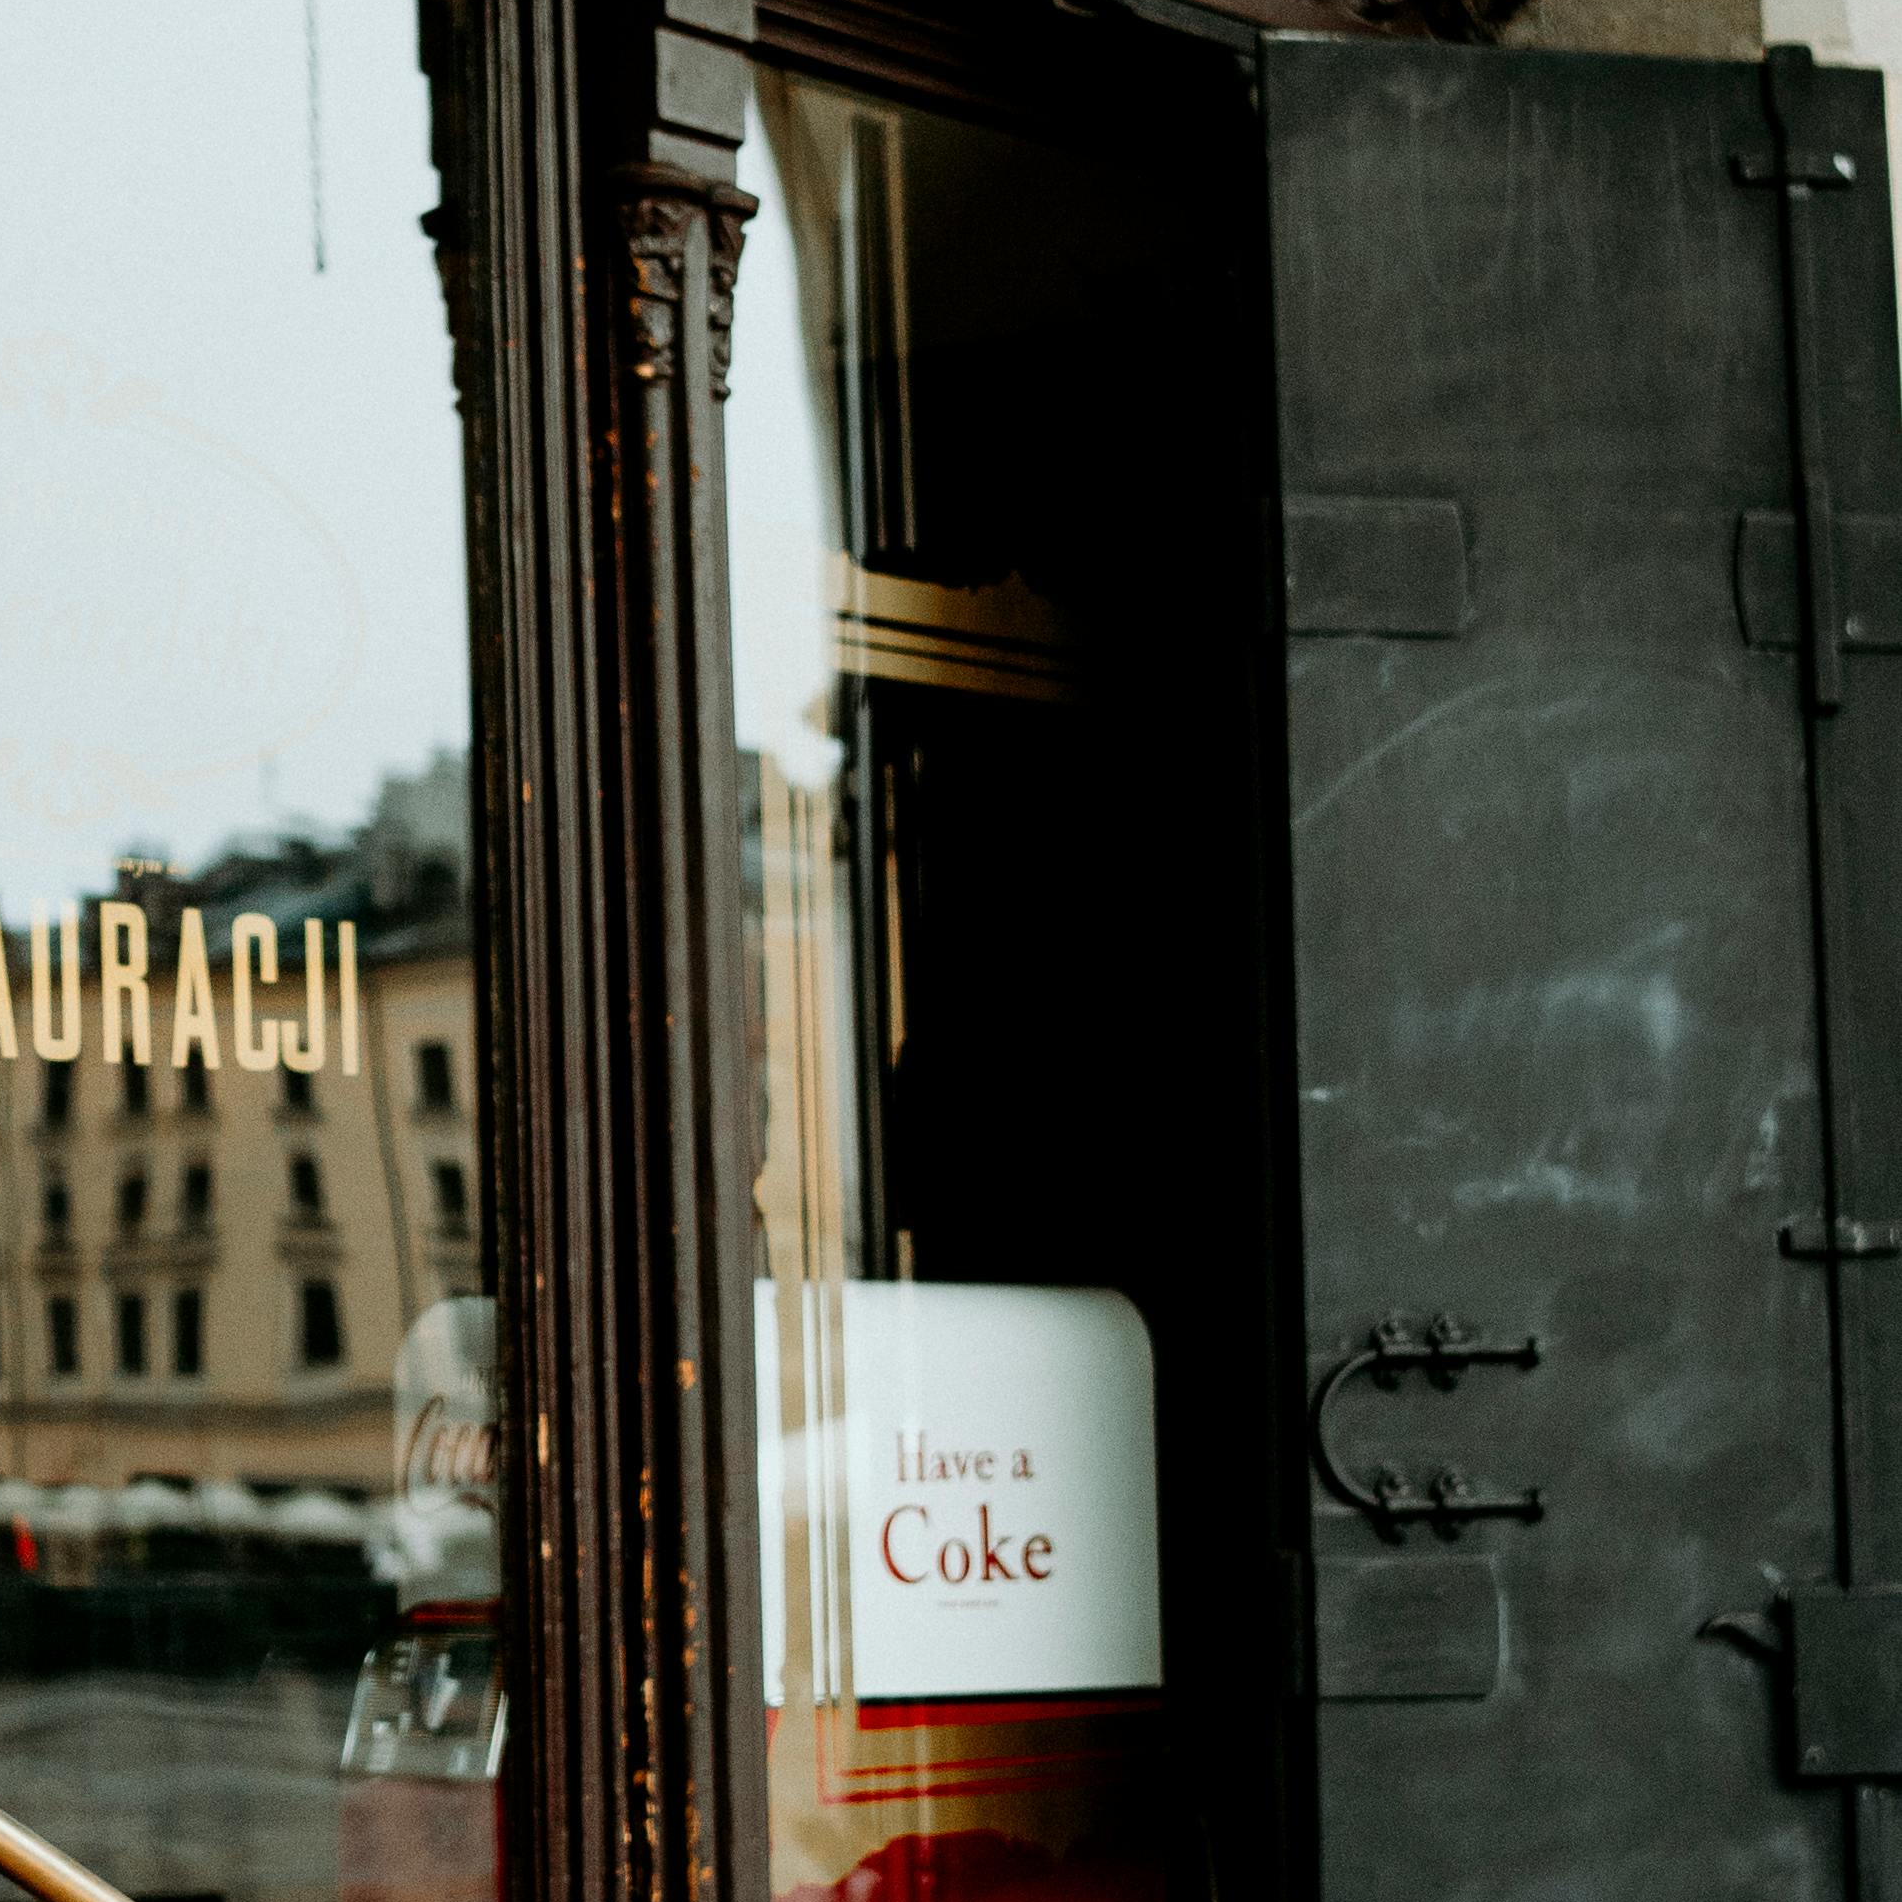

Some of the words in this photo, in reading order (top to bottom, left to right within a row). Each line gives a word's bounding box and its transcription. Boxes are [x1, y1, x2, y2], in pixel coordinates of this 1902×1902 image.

[897, 1430, 995, 1482] Have
[1012, 1448, 1033, 1480] a
[882, 1503, 1053, 1584] Coke
